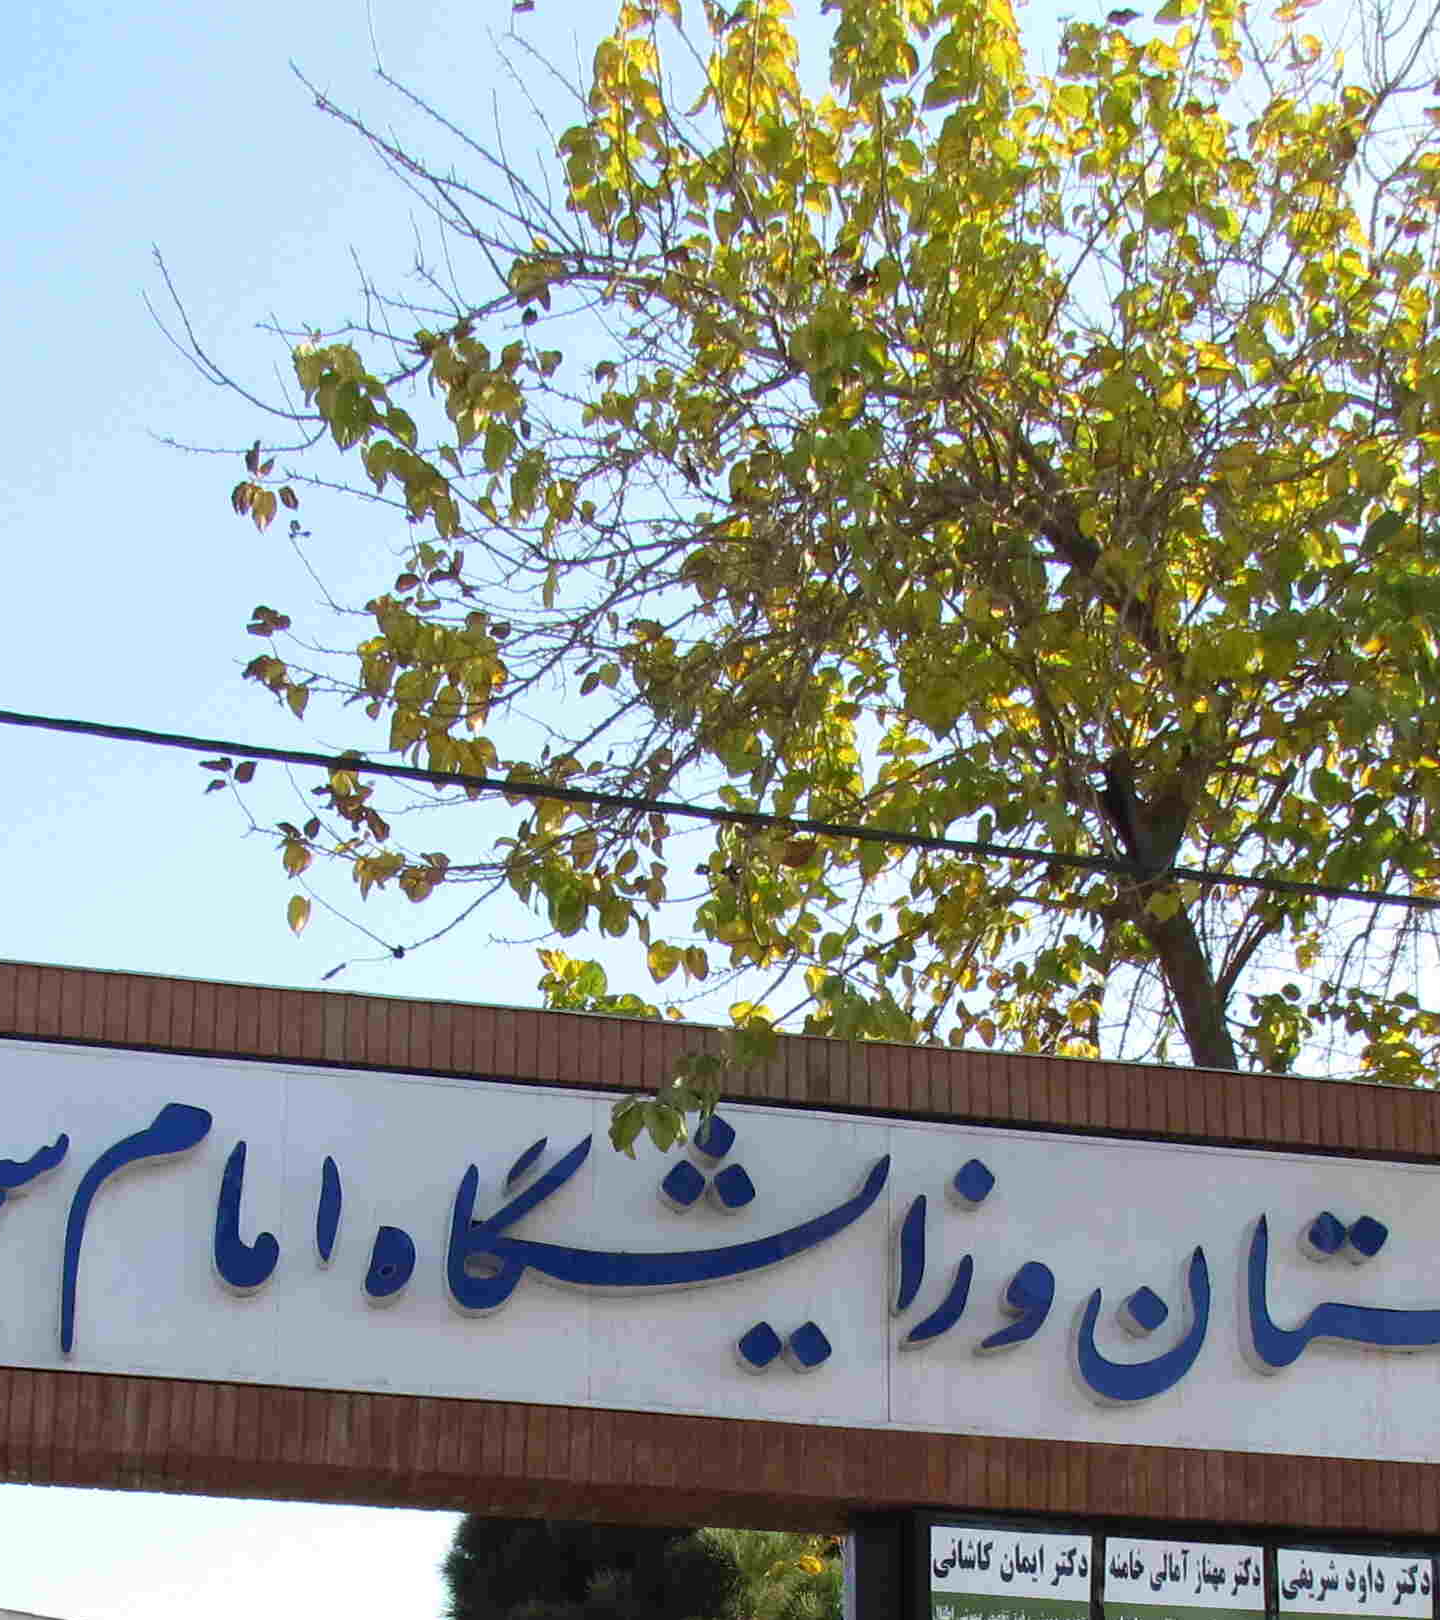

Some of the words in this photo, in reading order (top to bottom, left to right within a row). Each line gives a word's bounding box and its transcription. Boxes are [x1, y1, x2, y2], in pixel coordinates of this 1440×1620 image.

[61, 1102, 343, 1357] امام
[362, 1112, 996, 1375] زایشگاه
[976, 1258, 1055, 1354] و
[1000, 1544, 1044, 1582] ایمان
[1051, 1548, 1088, 1585] دکتر
[1231, 1558, 1261, 1596] دکتر
[1281, 1559, 1339, 1600] شریفی
[1345, 1563, 1384, 1602] داود
[1393, 1564, 1430, 1604] دکتر
